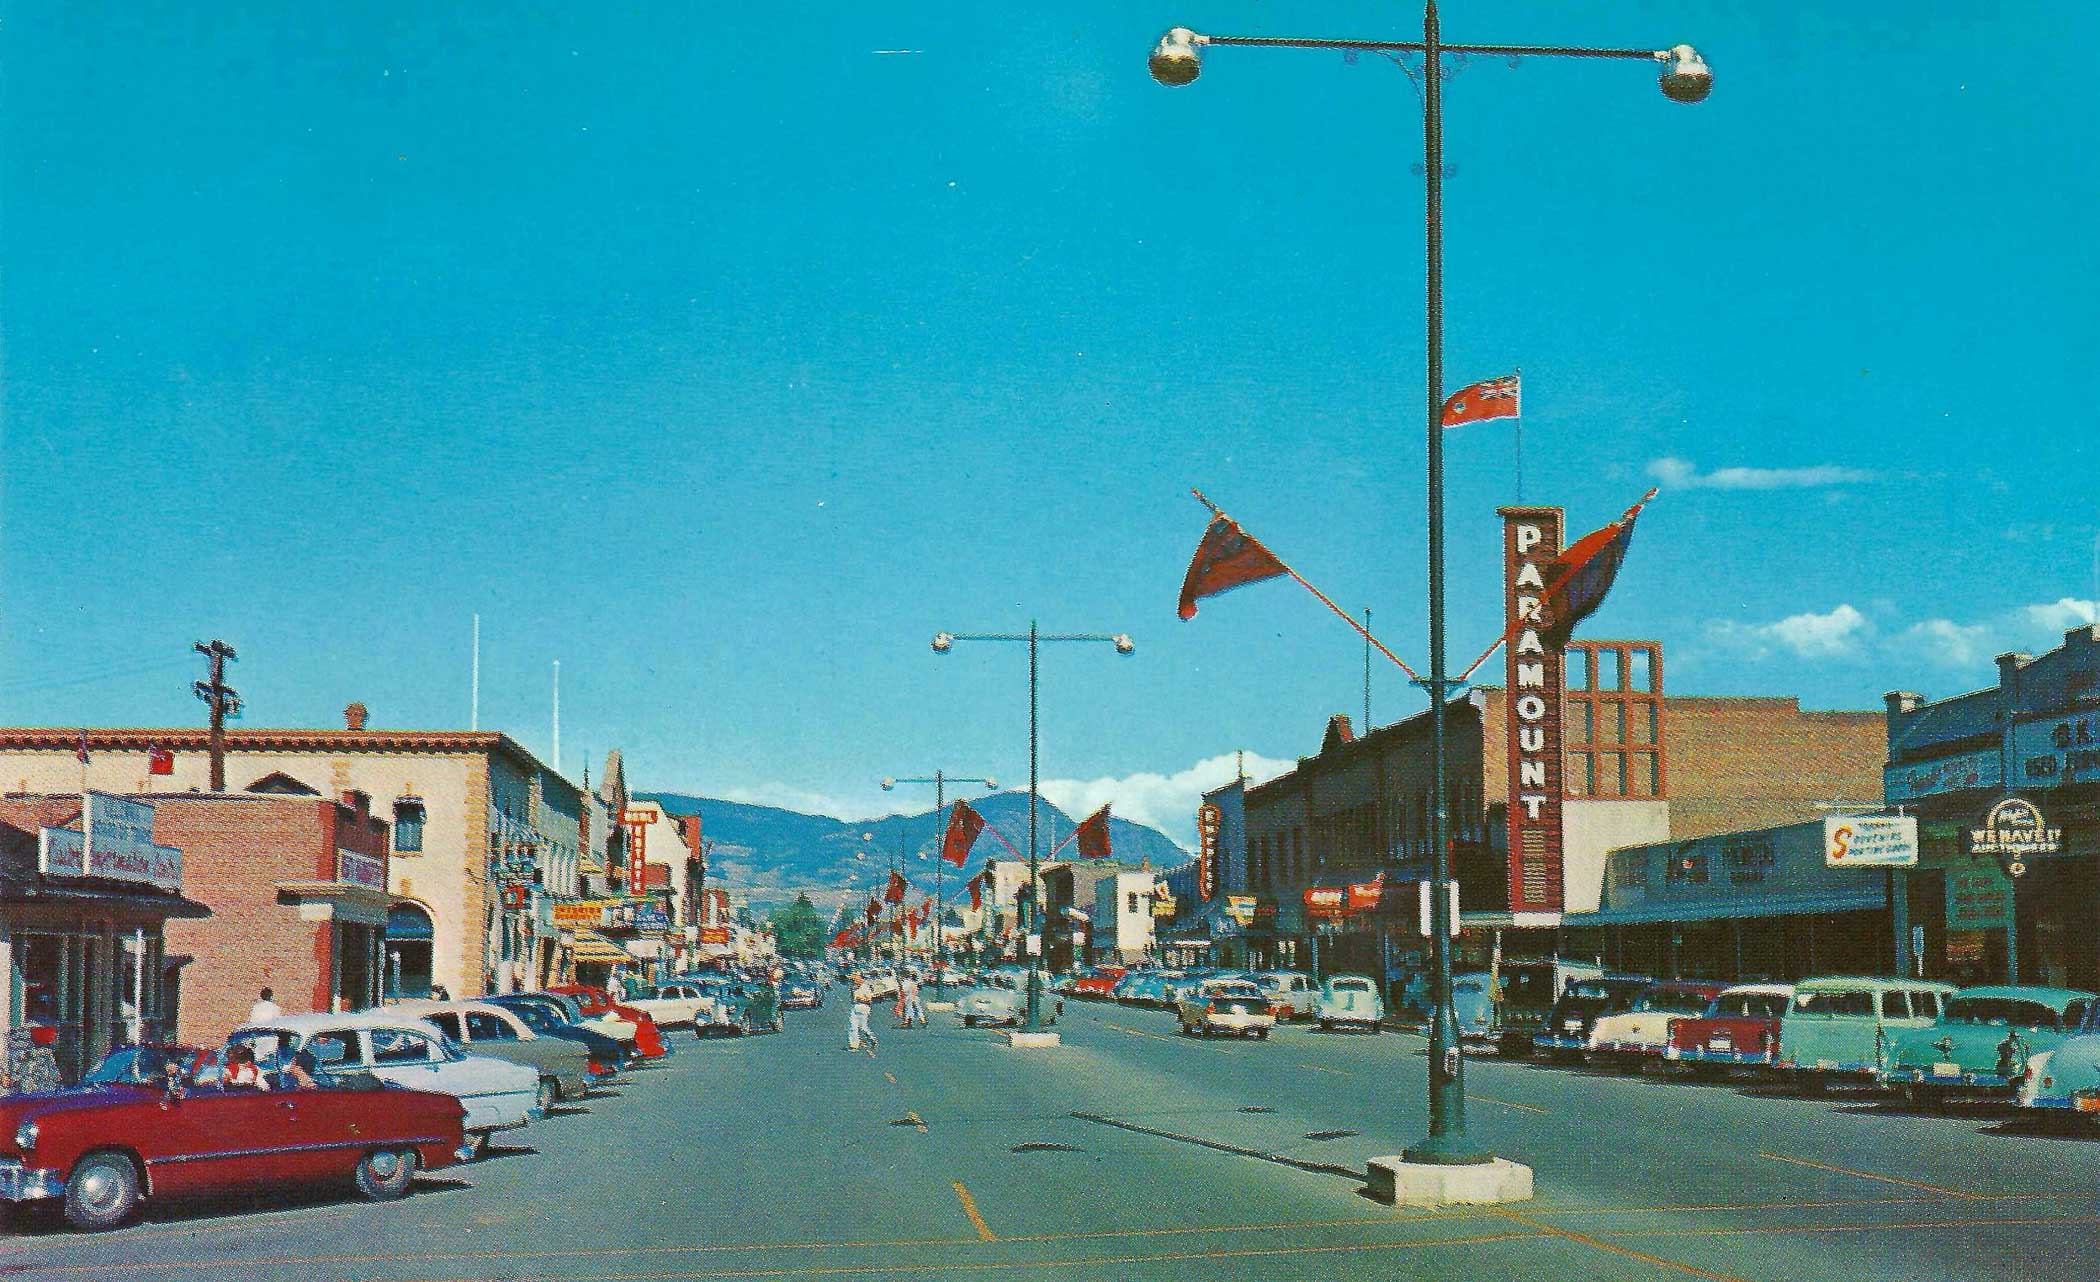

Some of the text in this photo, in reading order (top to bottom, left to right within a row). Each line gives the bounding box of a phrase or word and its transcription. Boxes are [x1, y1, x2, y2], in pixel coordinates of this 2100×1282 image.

[1516, 524, 1547, 820] PARAMOUNT
[1970, 828, 2063, 843] WE HAVE IT
